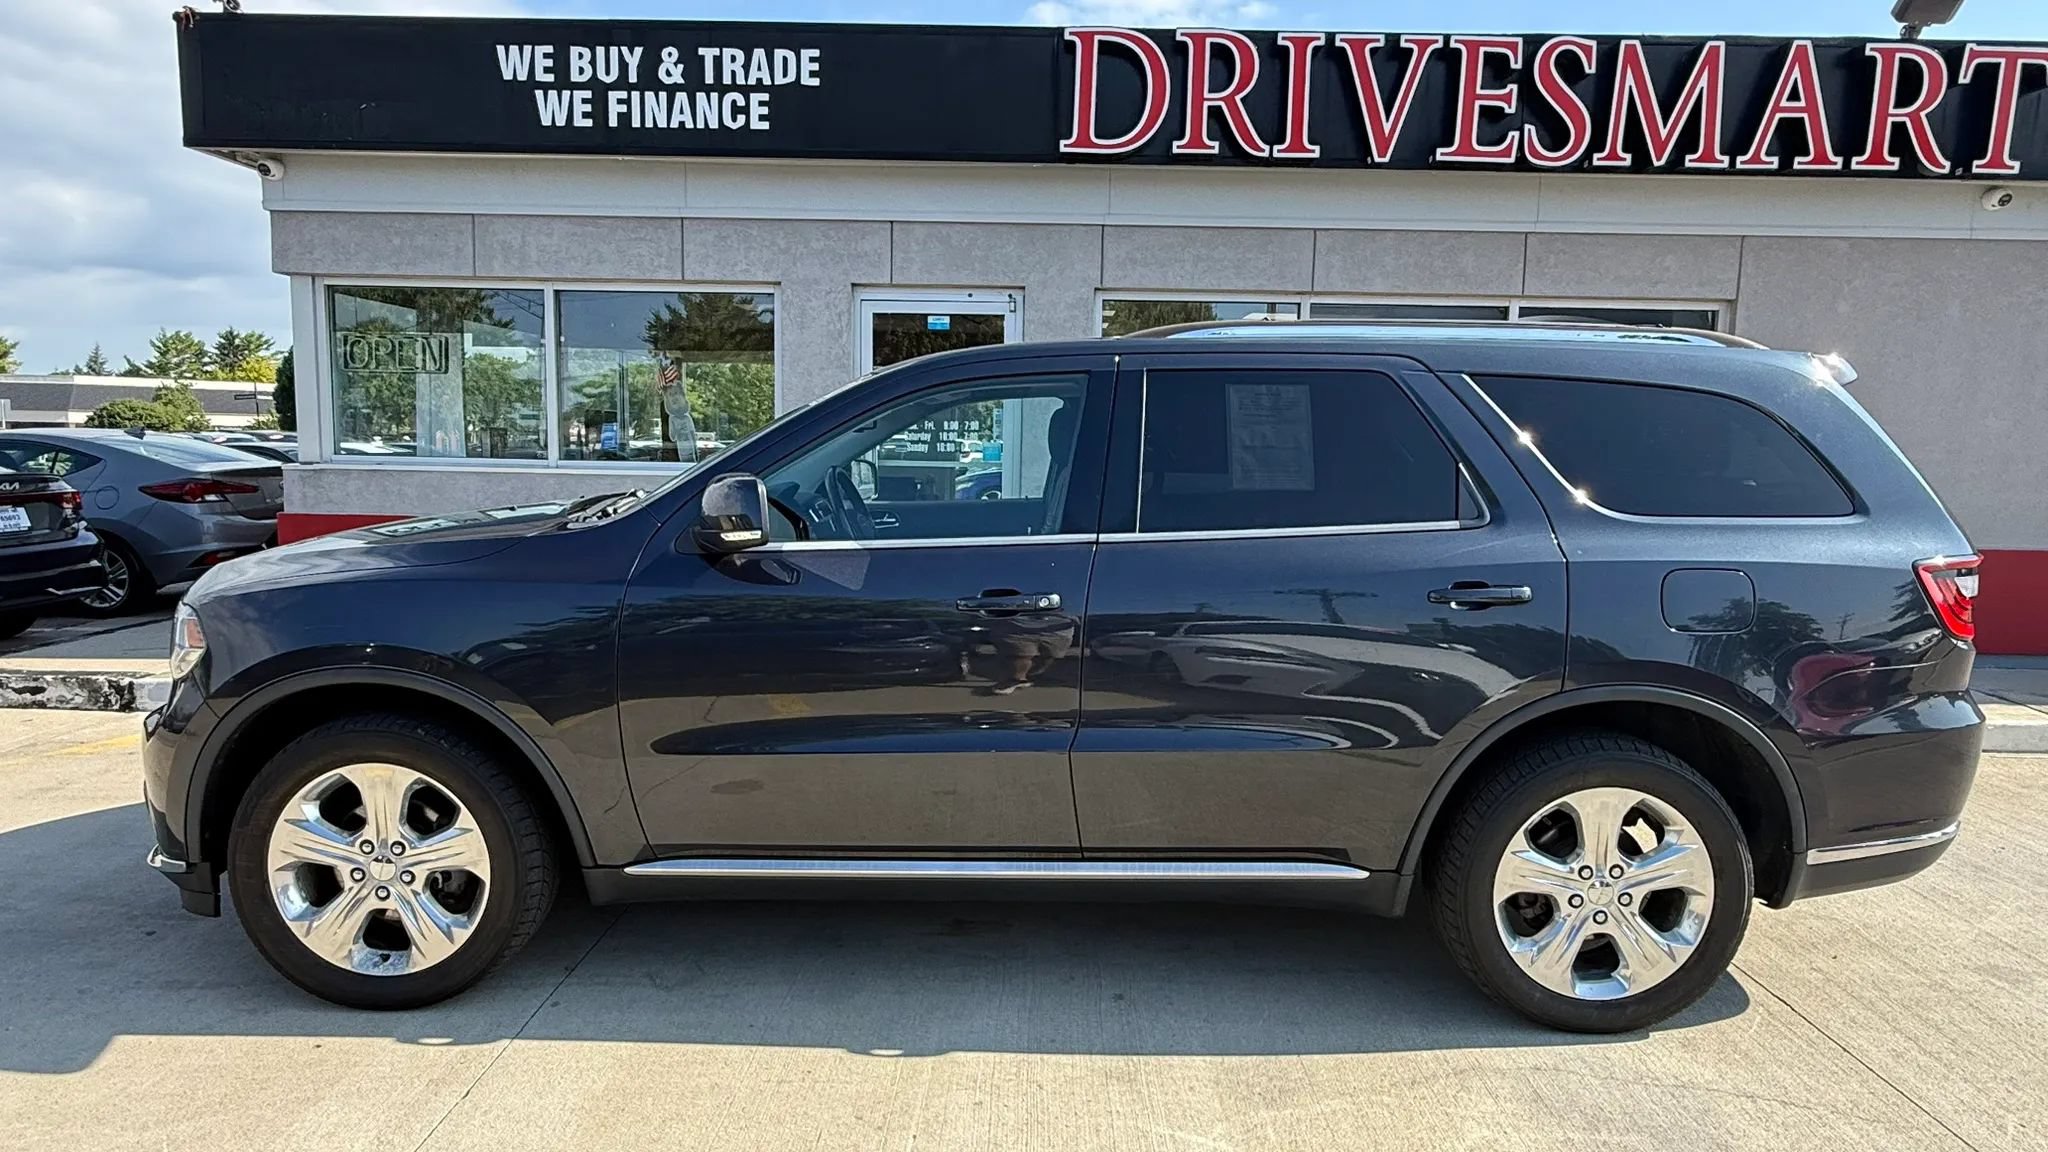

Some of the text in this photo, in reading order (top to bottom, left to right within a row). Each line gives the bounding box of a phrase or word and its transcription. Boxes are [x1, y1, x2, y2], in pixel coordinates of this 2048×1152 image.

[496, 45, 821, 86] WE BUY & TRADE
[535, 89, 770, 130] WE FINANCE
[1059, 27, 2048, 174] DRIVESMART
[346, 337, 444, 370] OPEN
[904, 431, 931, 442] Saturday
[907, 442, 929, 453] Sunday
